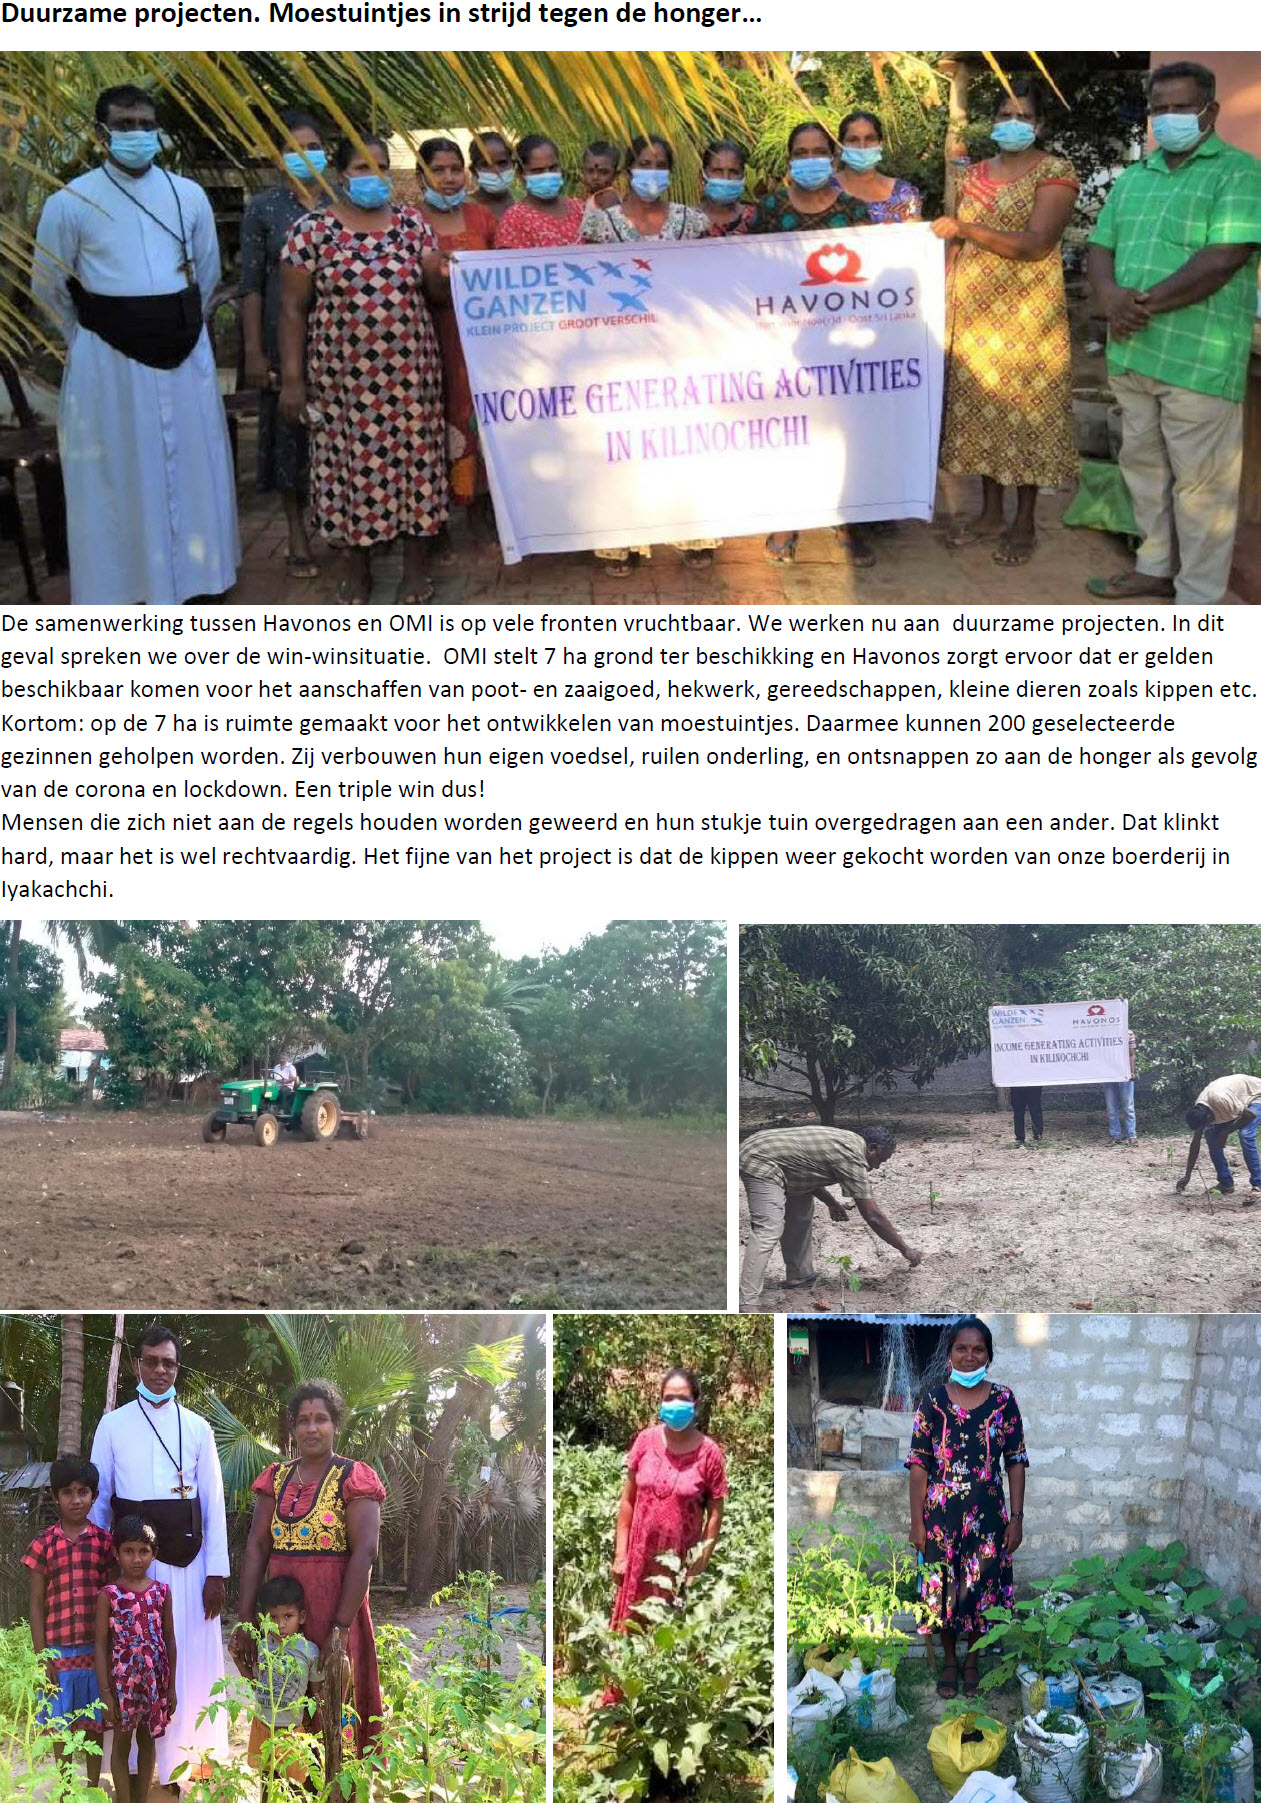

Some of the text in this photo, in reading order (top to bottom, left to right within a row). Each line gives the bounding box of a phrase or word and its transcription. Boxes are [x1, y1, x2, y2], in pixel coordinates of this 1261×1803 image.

[2, 2, 127, 23] Duurzame
[135, 1, 260, 28] projecten.
[269, 1, 431, 28] Moestuintjes
[439, 1, 461, 23] in
[468, 1, 531, 28] strijd
[538, 3, 609, 28] tegen
[615, 1, 647, 23] de
[461, 263, 558, 291] WILDE
[464, 289, 586, 320] GANZEN
[756, 287, 914, 315] HAVONOS
[466, 323, 501, 337] KLEIN
[504, 320, 555, 335] PROJECT
[558, 316, 601, 330] GROOT
[585, 369, 764, 414] GENERATING
[775, 358, 921, 398] ACTIVITIES
[606, 415, 809, 462] IN KILINOCHCHI
[2, 613, 1225, 636] De samenwerking tussen Havonos en OMI is op vele fronten vruchtbaar. We werken nu aan duurzame projecten. In dit
[0, 646, 1213, 669] geval spreken we over de win-winsituatie. OMI stelt 7 ha grond ter beschikking en Havonos zorgt ervoor dat er gelden
[2, 713, 1175, 736] Kortom: op de 7 ha is ruimte gemaakt voor het ontwikkelen van moestuintjes. Daarmee kunnen 200 geselecteerde
[0, 746, 1258, 769] gezinnen geholpen worden. Zij verbouwen hun eigen voedsel, ruilen onderling, en ontsnappen zo aan de honger als gevolg
[2, 812, 1220, 835] Mensen die zich niet aan de regels houden worden geweerd en hun stukje tuin overgedragen aan een ander. Dat klinkt
[1, 846, 1230, 869] hard, maar het is wel rechtvaardig. Het fijne van het project is dat de kippen weer gekocht worden van onze boerderij in
[2, 879, 114, 902] Iyakachchi.
[991, 1009, 1017, 1017] WILDE
[991, 1017, 1025, 1025] GANZEN
[1072, 1016, 1120, 1025] HAVONOS
[994, 1036, 1123, 1052] INCOME GENERATING ACTIVITIES
[1030, 1052, 1089, 1063] IN KILINOCHCHI
